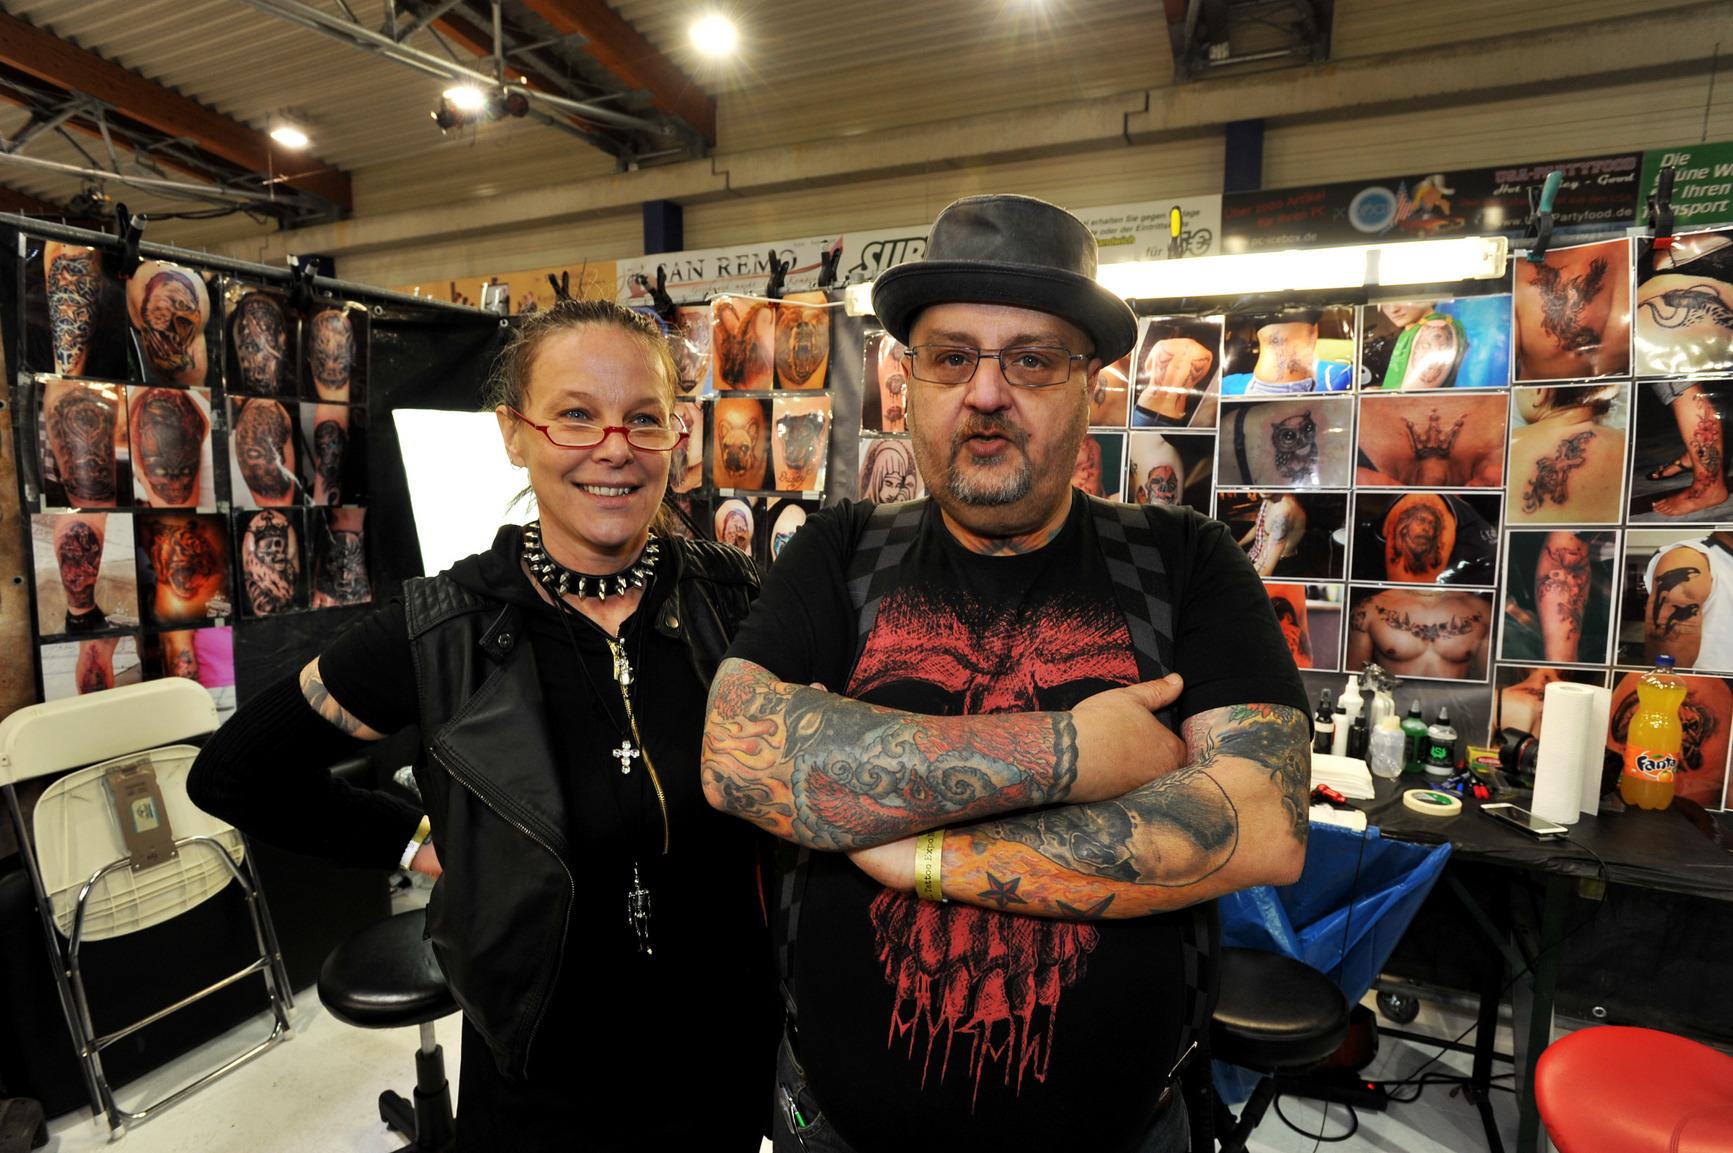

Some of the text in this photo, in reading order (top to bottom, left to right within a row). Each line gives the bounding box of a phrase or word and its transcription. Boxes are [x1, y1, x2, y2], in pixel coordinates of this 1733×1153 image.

[1661, 153, 1691, 167] Die
[1654, 167, 1710, 186] üne
[1681, 184, 1732, 199] Ihren
[1642, 200, 1730, 218] Tnsport
[716, 249, 798, 278] REMO
[1636, 755, 1676, 771] Fanta
[924, 838, 935, 861] Expo
[924, 863, 932, 893] Tattoo
